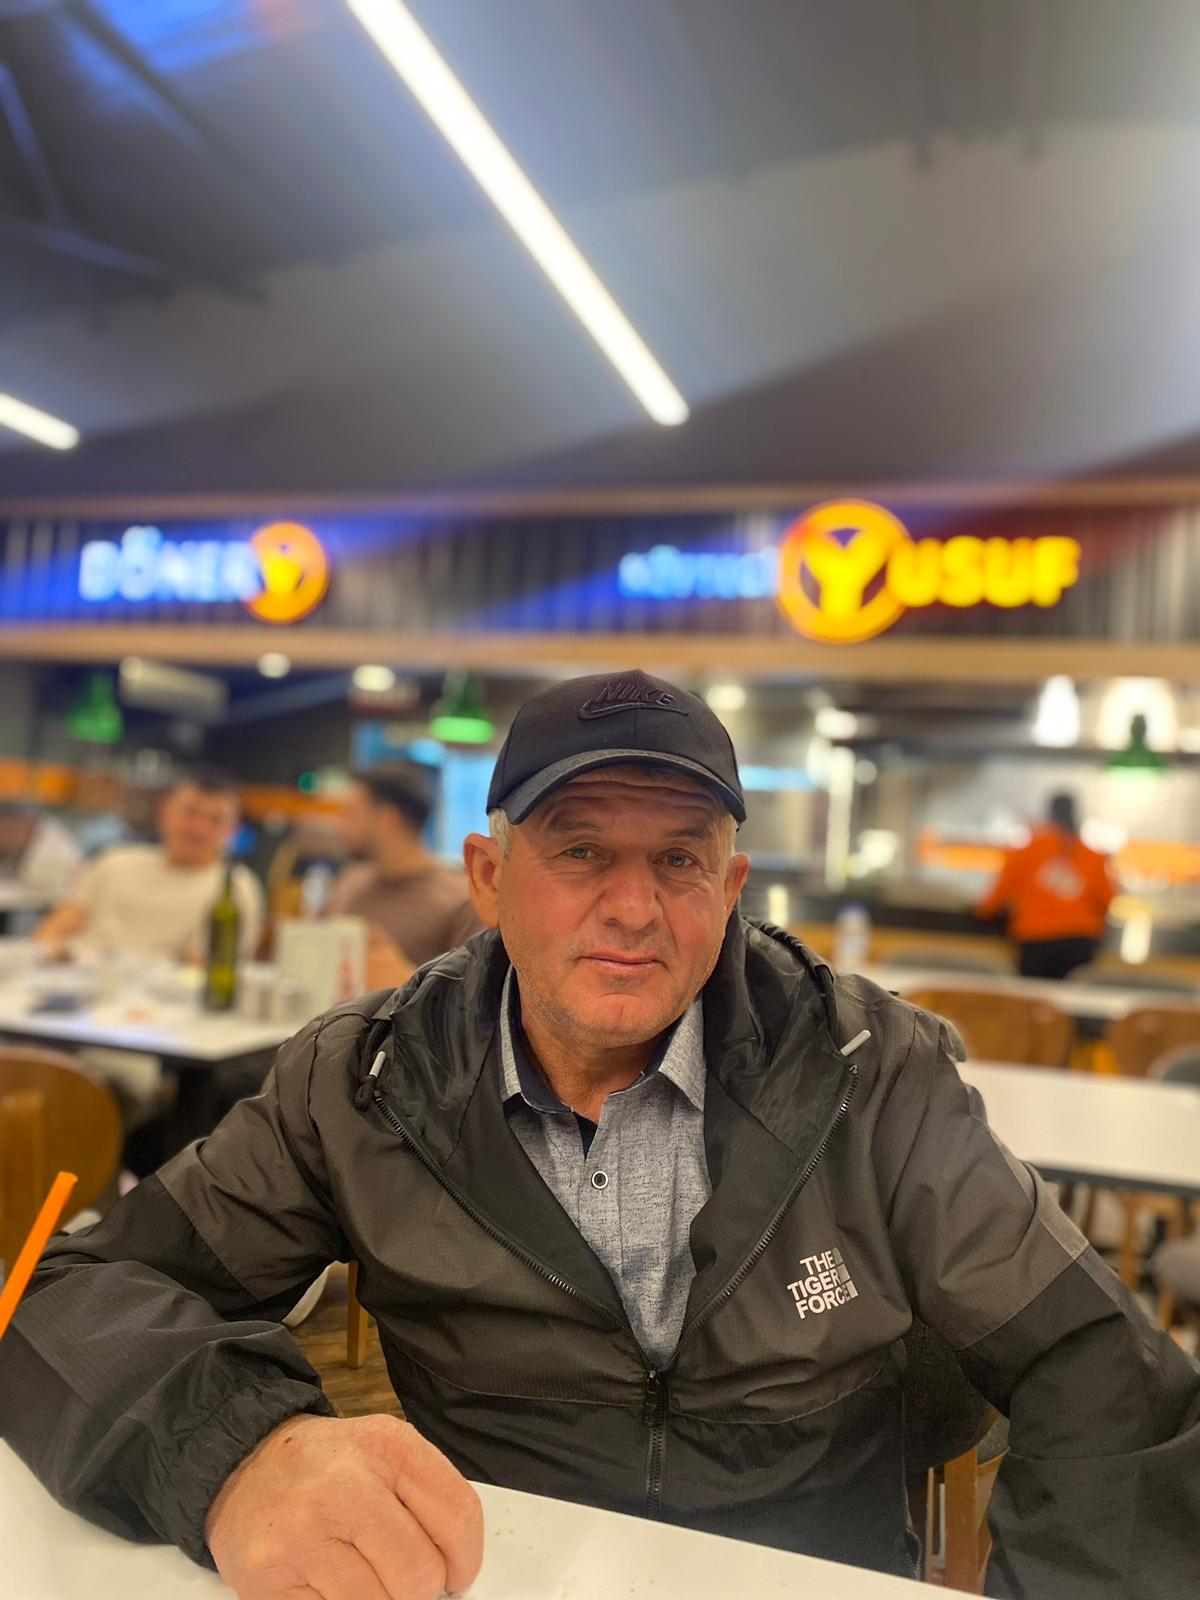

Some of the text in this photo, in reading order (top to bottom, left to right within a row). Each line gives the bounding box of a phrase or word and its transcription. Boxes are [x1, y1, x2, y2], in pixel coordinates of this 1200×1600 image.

[779, 499, 1080, 643] YUSUF
[597, 681, 675, 706] NIKE
[800, 1250, 836, 1275] THE
[787, 1268, 841, 1300] TIGER
[795, 1284, 851, 1319] FORCE
